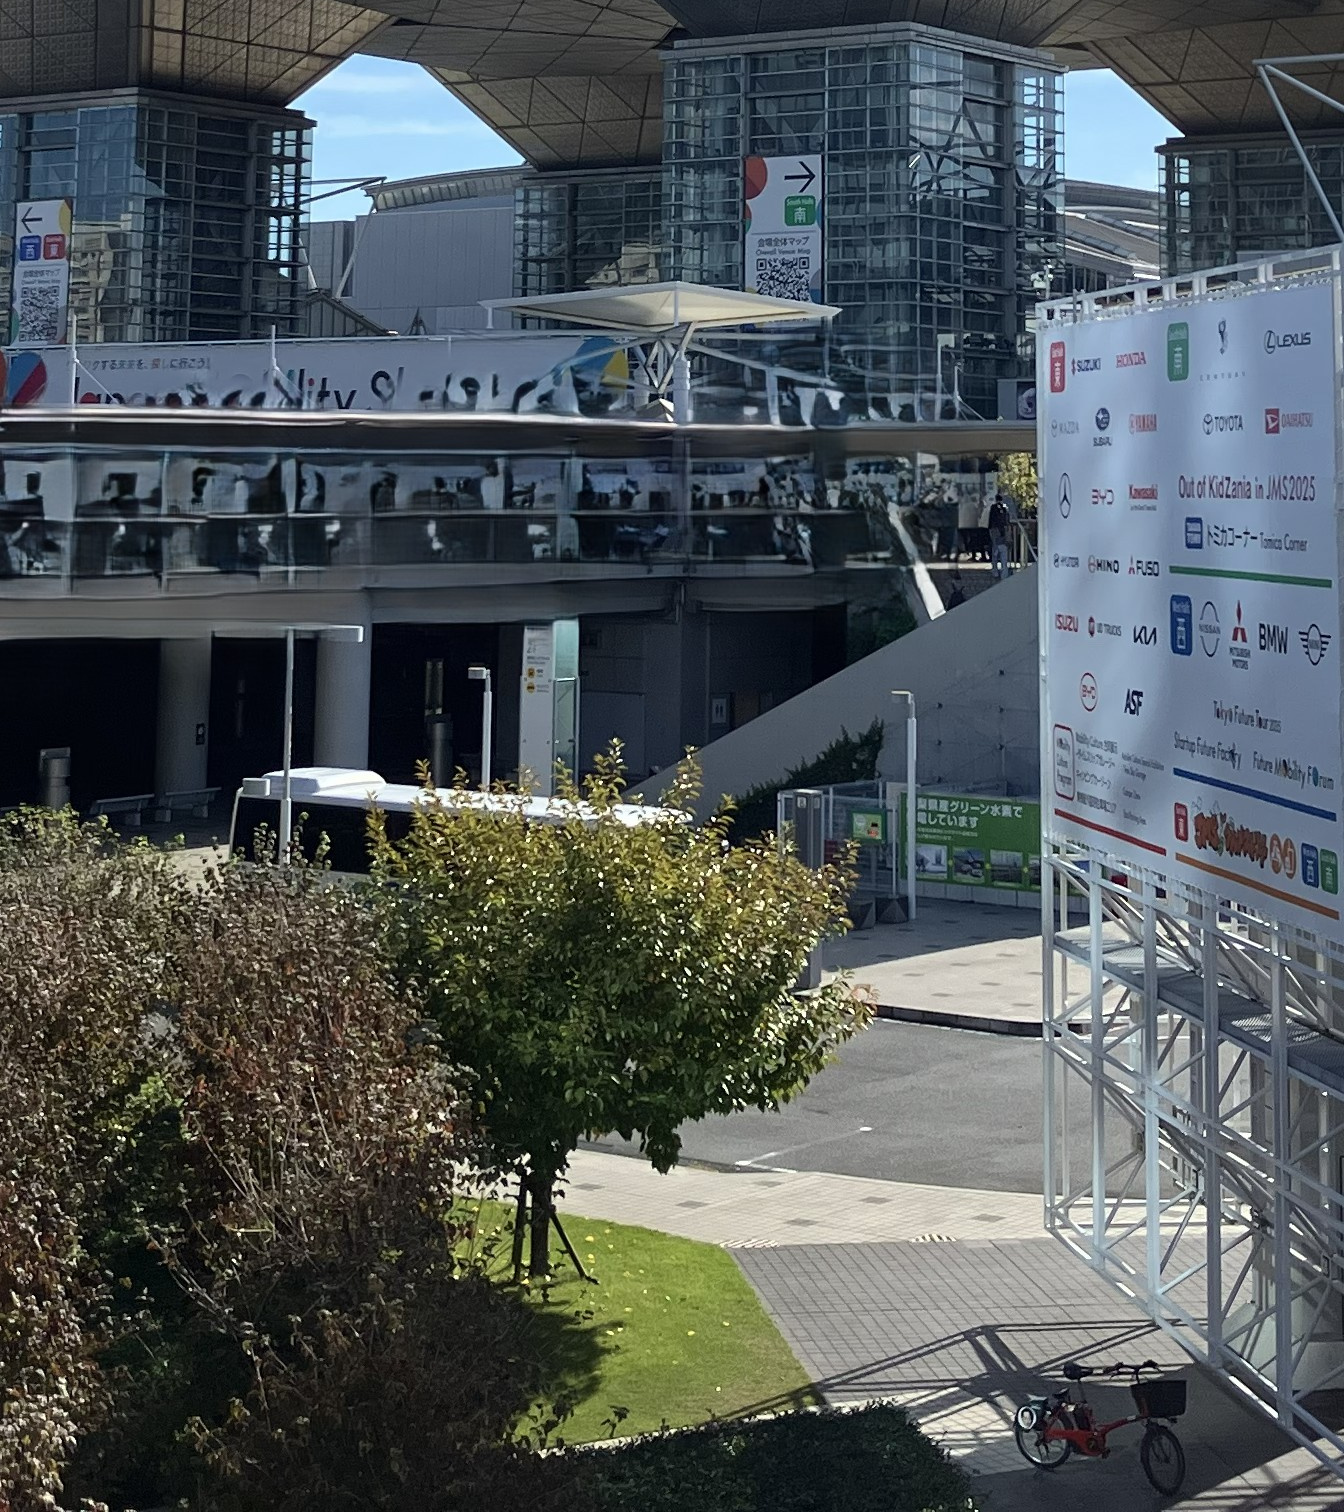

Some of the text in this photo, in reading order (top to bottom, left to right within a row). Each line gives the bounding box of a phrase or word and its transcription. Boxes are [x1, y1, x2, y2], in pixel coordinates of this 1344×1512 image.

[793, 206, 806, 224] 南
[757, 236, 810, 248] 会場全体マップ
[1277, 332, 1312, 347] LEXUS
[1077, 357, 1101, 372] SUZUKI
[1116, 352, 1146, 368] HONDA
[1214, 415, 1243, 432] TOYOTA
[1178, 475, 1195, 499] Out
[1197, 475, 1206, 499] of
[1208, 475, 1251, 500] KidZania
[1255, 477, 1264, 500] in
[1092, 489, 1114, 505] BYD
[1207, 524, 1258, 548] トミカコーナー
[1260, 532, 1283, 551] Tomica
[1284, 533, 1308, 552] Corner
[1096, 559, 1120, 574] HINO
[1136, 560, 1160, 577] FUSO
[1055, 613, 1078, 632] ISUZU
[1198, 623, 1221, 635] NISSAN
[1258, 623, 1288, 654] BMW
[1124, 689, 1143, 716] ASF
[1213, 700, 1233, 726] Tokyo
[1234, 705, 1255, 727] Future
[1196, 736, 1216, 759] Future
[1253, 751, 1334, 791] Future Mobility Forum
[917, 811, 979, 829] 電しています
